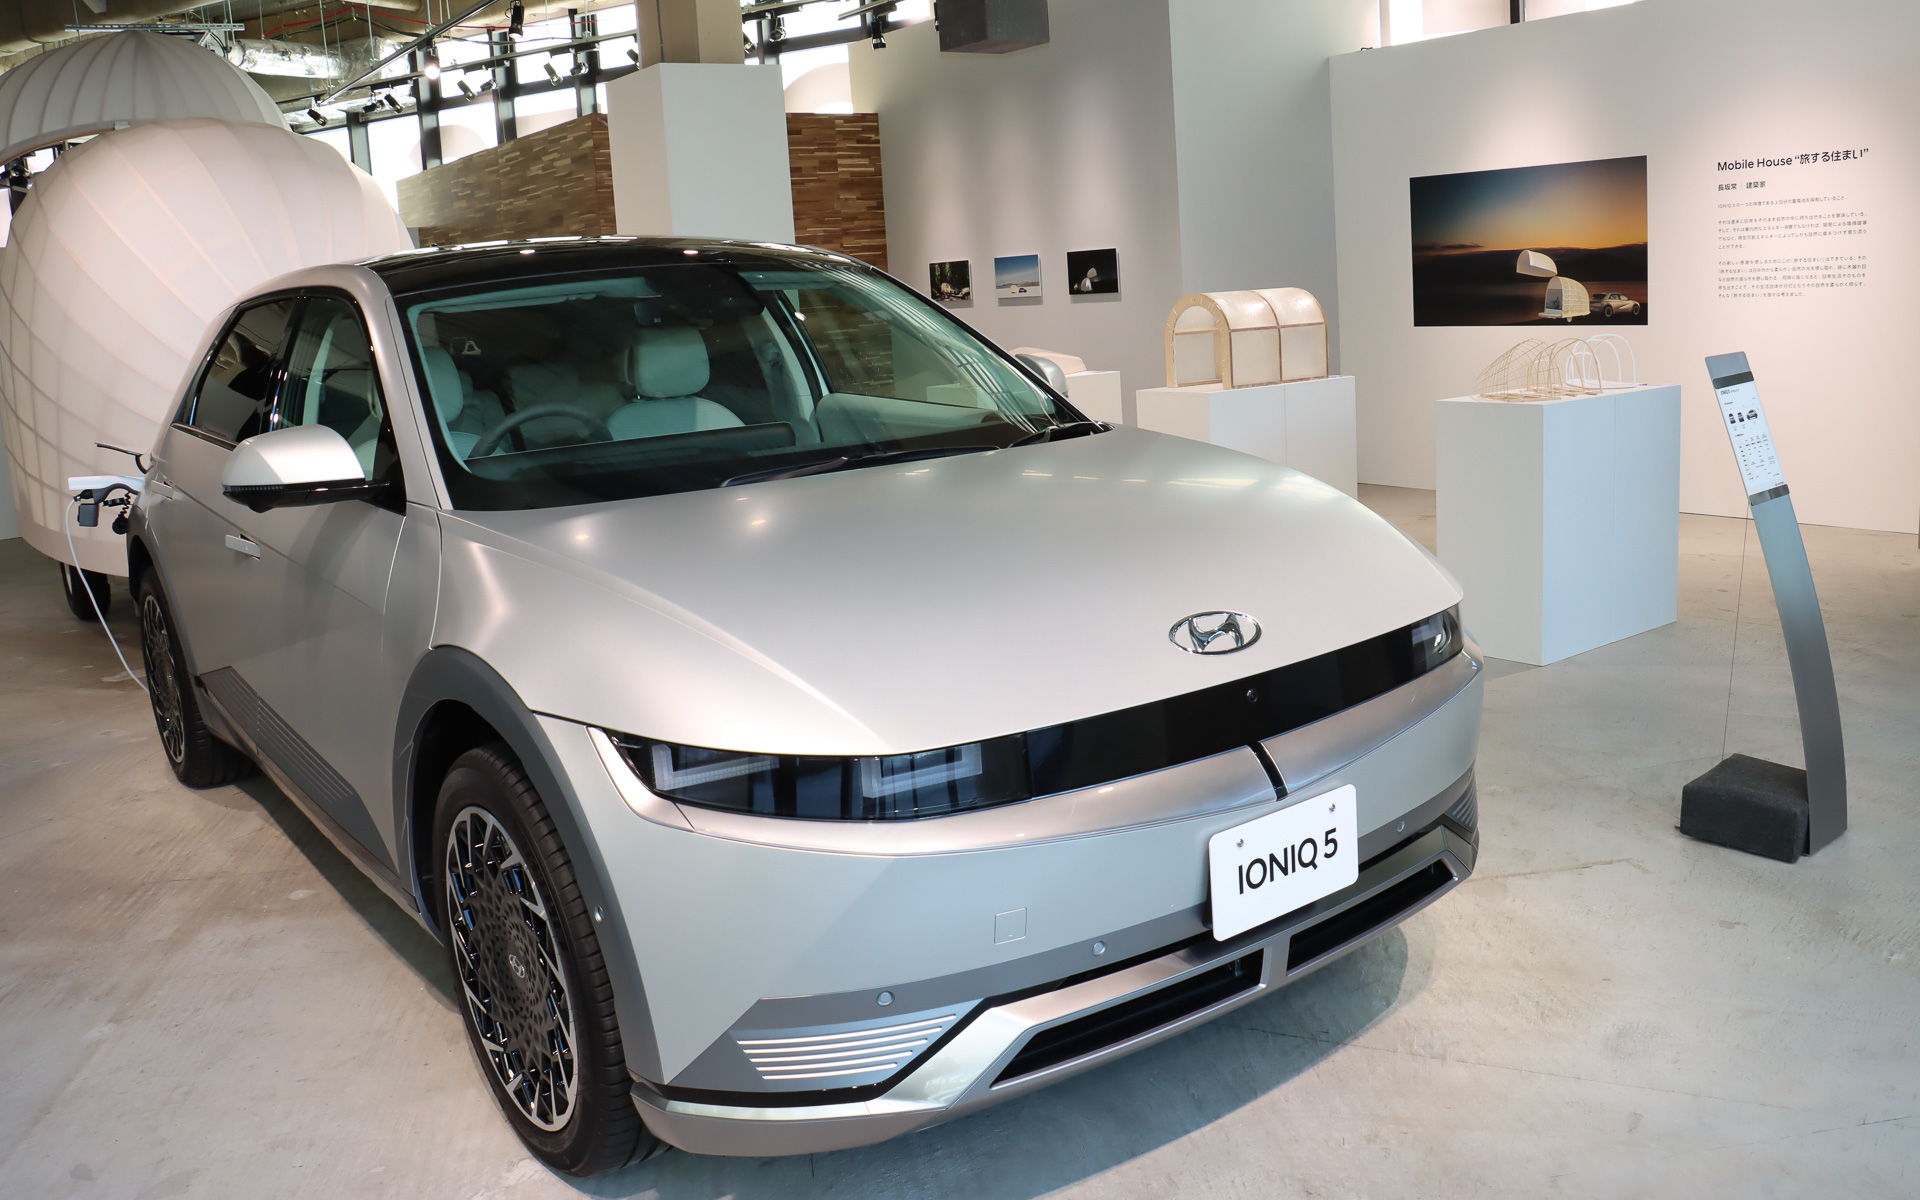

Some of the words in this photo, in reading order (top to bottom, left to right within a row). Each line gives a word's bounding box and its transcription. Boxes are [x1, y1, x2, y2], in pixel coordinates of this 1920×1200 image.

[1717, 159, 1754, 171] Mobile
[1757, 157, 1793, 168] House
[1238, 837, 1318, 895] IONIQ
[1323, 827, 1338, 859] 5
